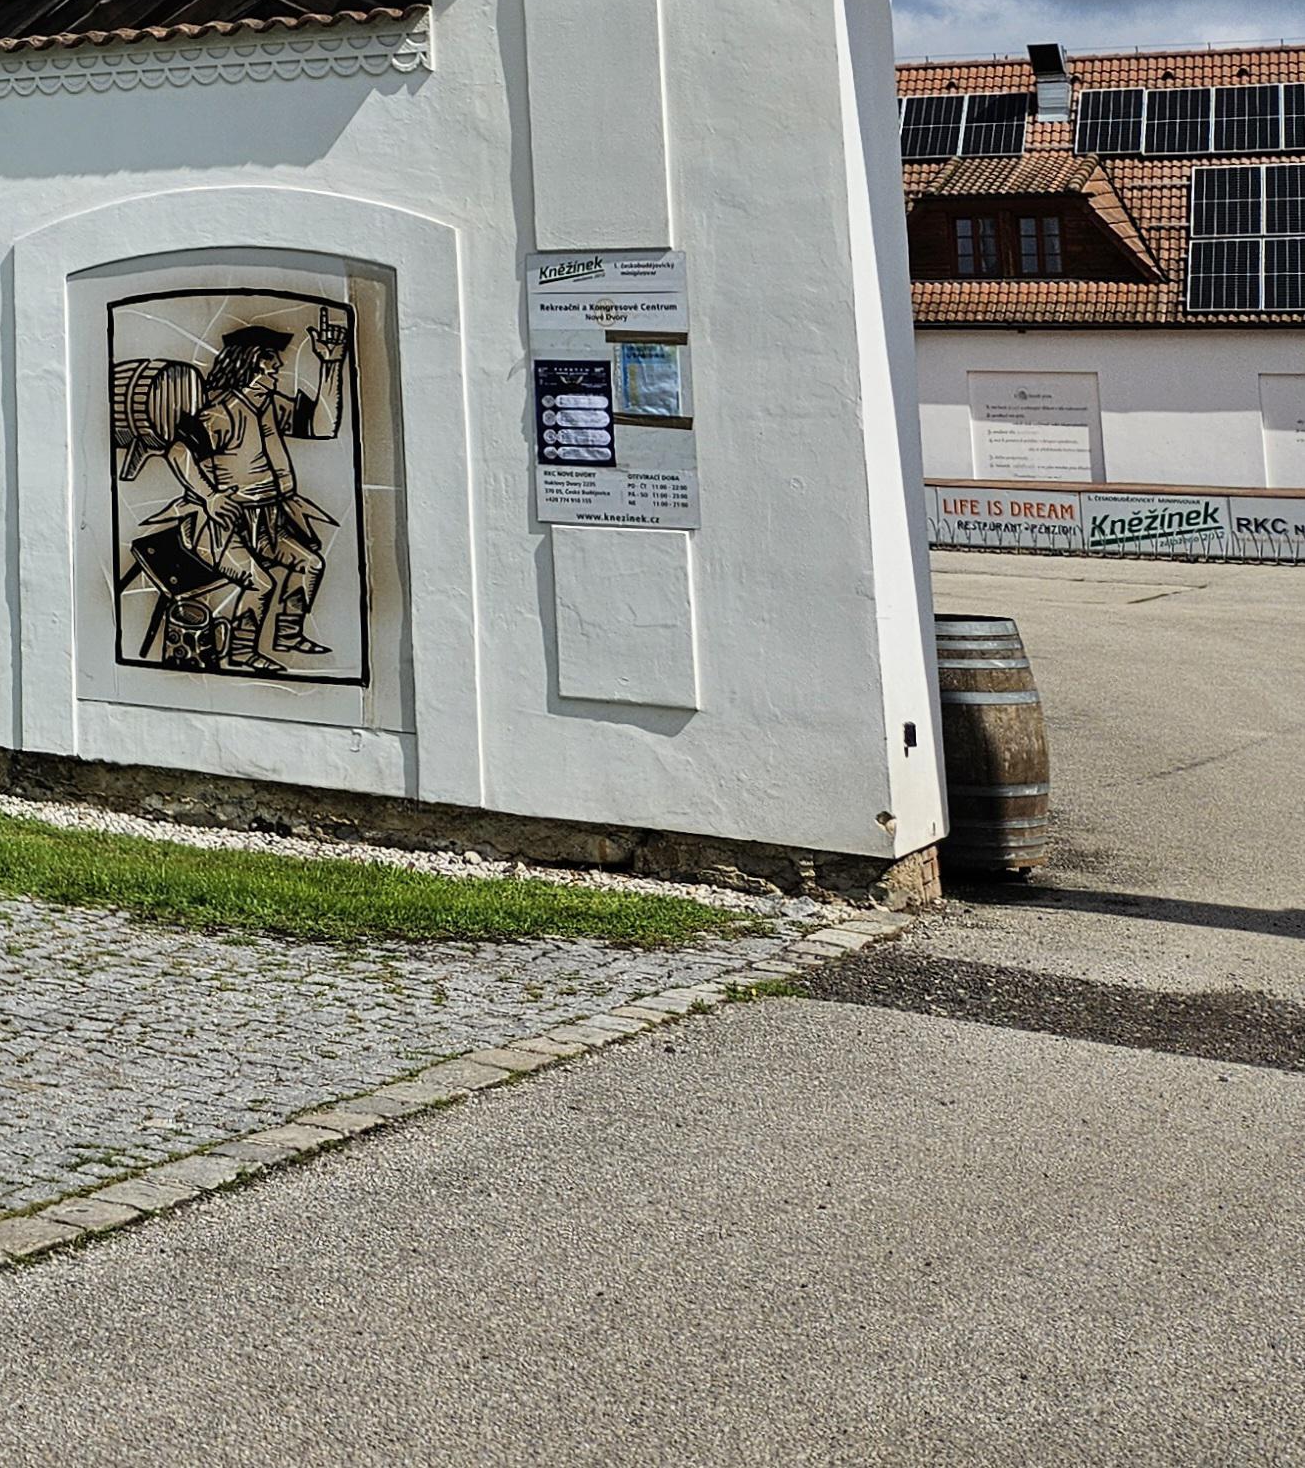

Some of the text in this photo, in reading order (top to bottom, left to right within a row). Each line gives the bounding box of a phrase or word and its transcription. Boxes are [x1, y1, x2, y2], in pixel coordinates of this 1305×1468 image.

[539, 255, 603, 280] Kněžínek
[540, 303, 580, 311] Rekreační
[589, 303, 638, 312] Kongresové
[640, 303, 678, 311] Centrum
[585, 313, 628, 322] Nové Dvory
[661, 474, 680, 482] DOBA
[943, 498, 1075, 520] LIFE IS DREAM
[576, 512, 660, 523] www.knezinek.cz
[1090, 501, 1220, 538] Kněžínek
[1236, 517, 1289, 534] RKC
